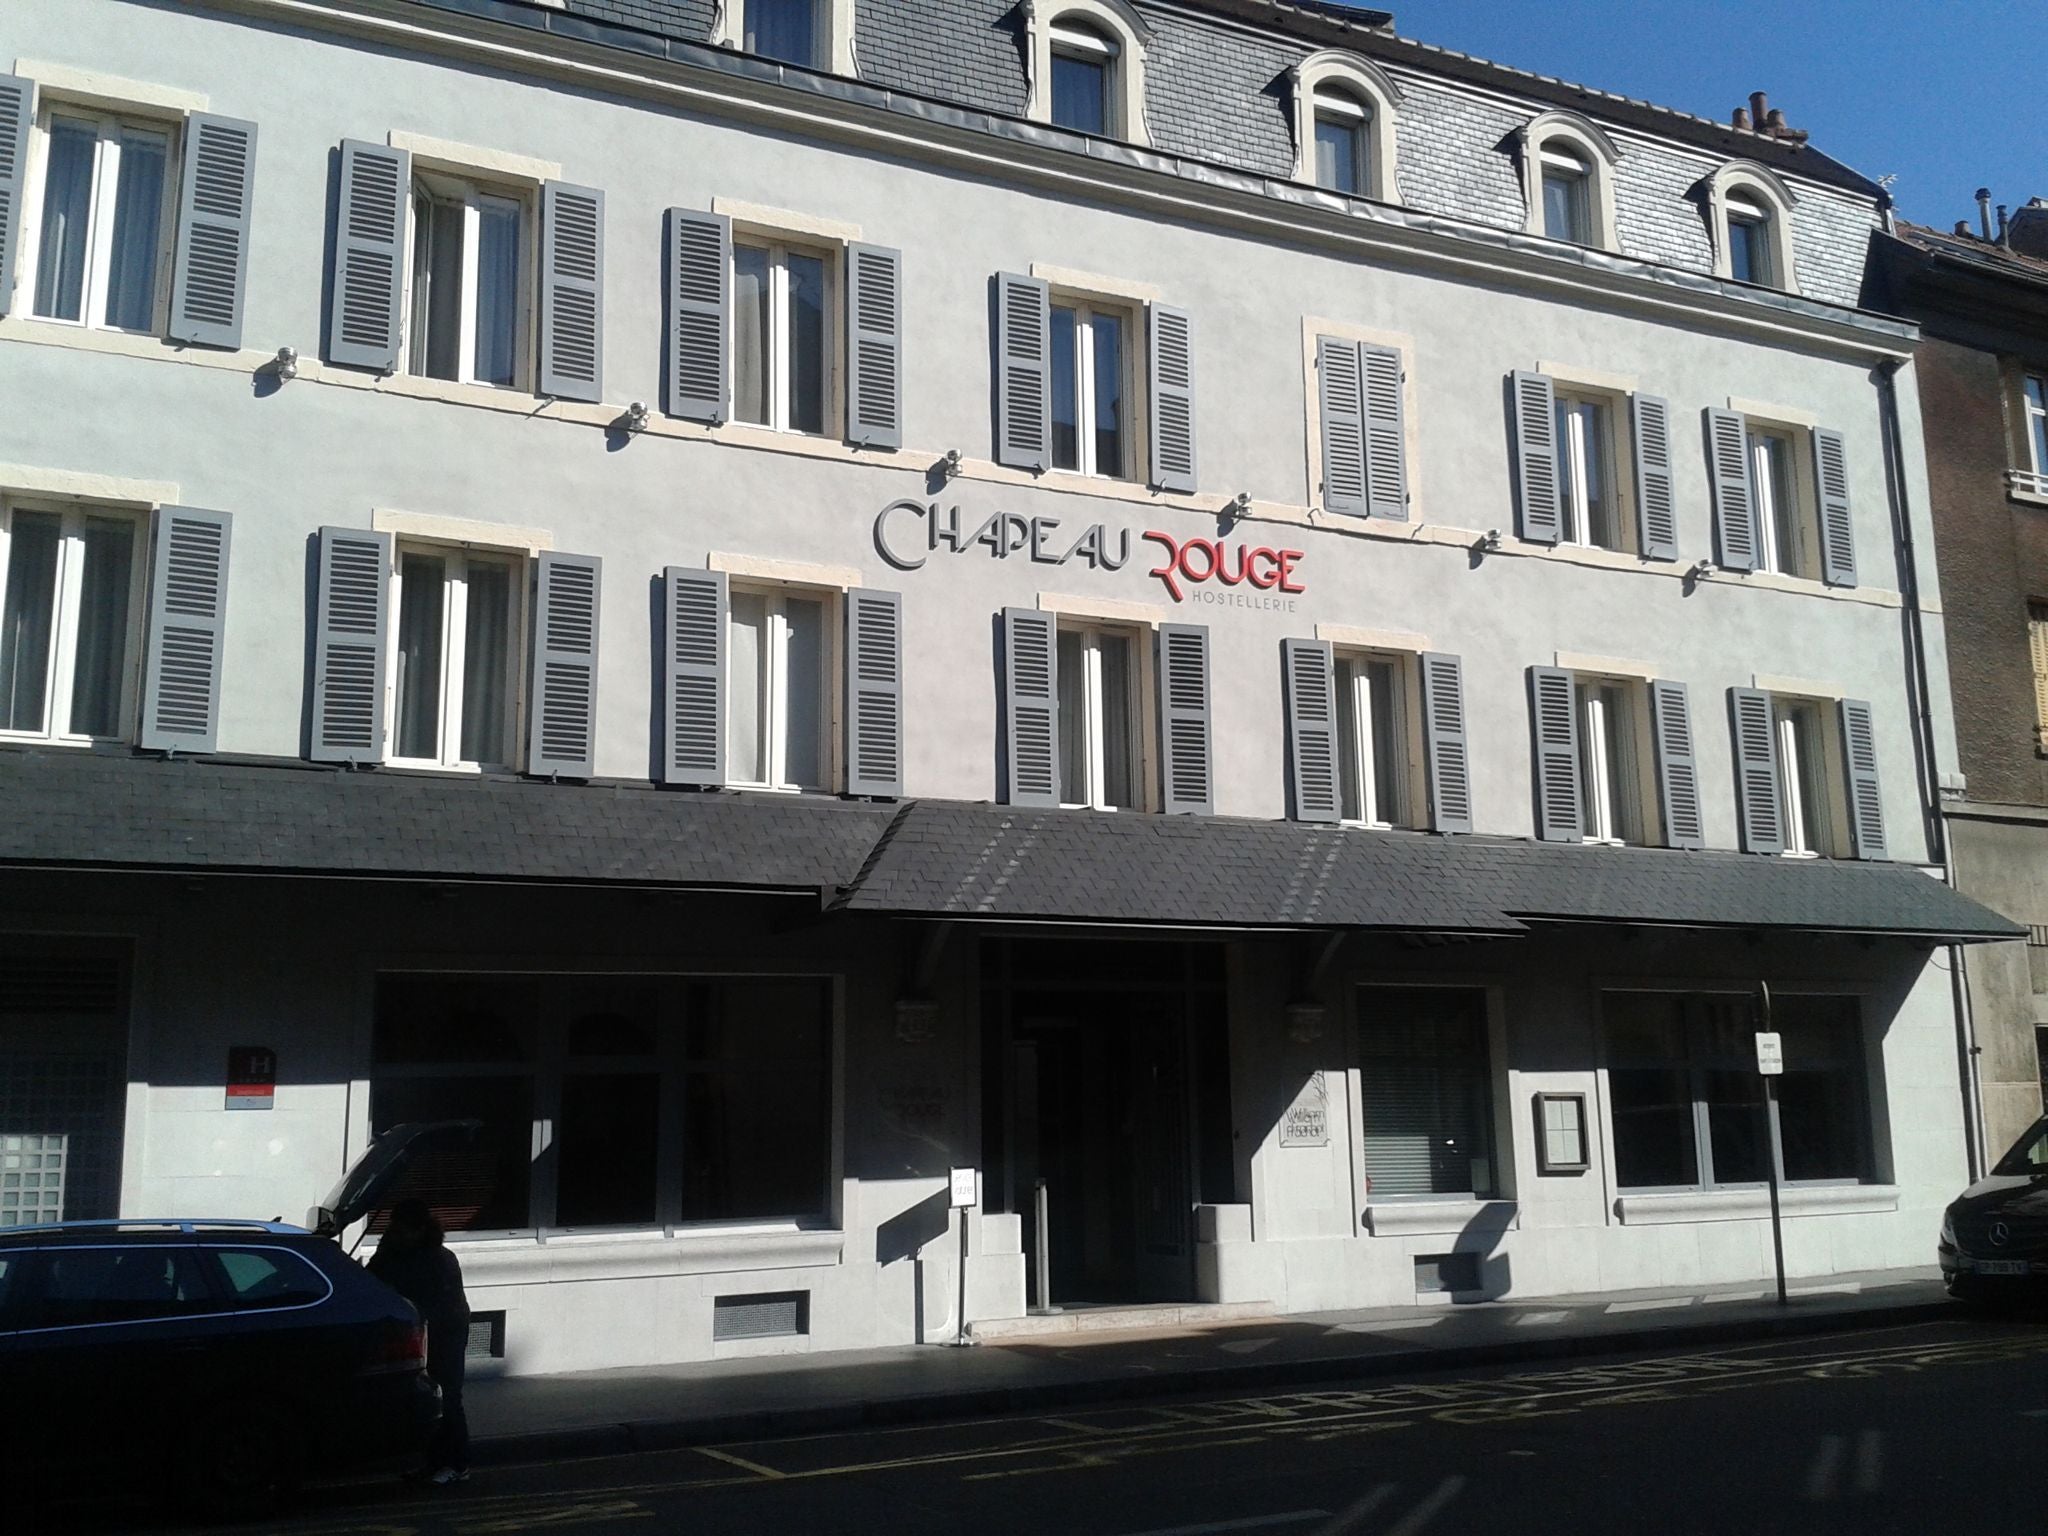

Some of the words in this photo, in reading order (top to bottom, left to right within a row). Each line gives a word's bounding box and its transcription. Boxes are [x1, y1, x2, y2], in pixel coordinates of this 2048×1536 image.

[873, 498, 1131, 571] CHAPEAU
[1142, 530, 1306, 602] ROUGE
[1192, 590, 1296, 613] HOSTELLERIE
